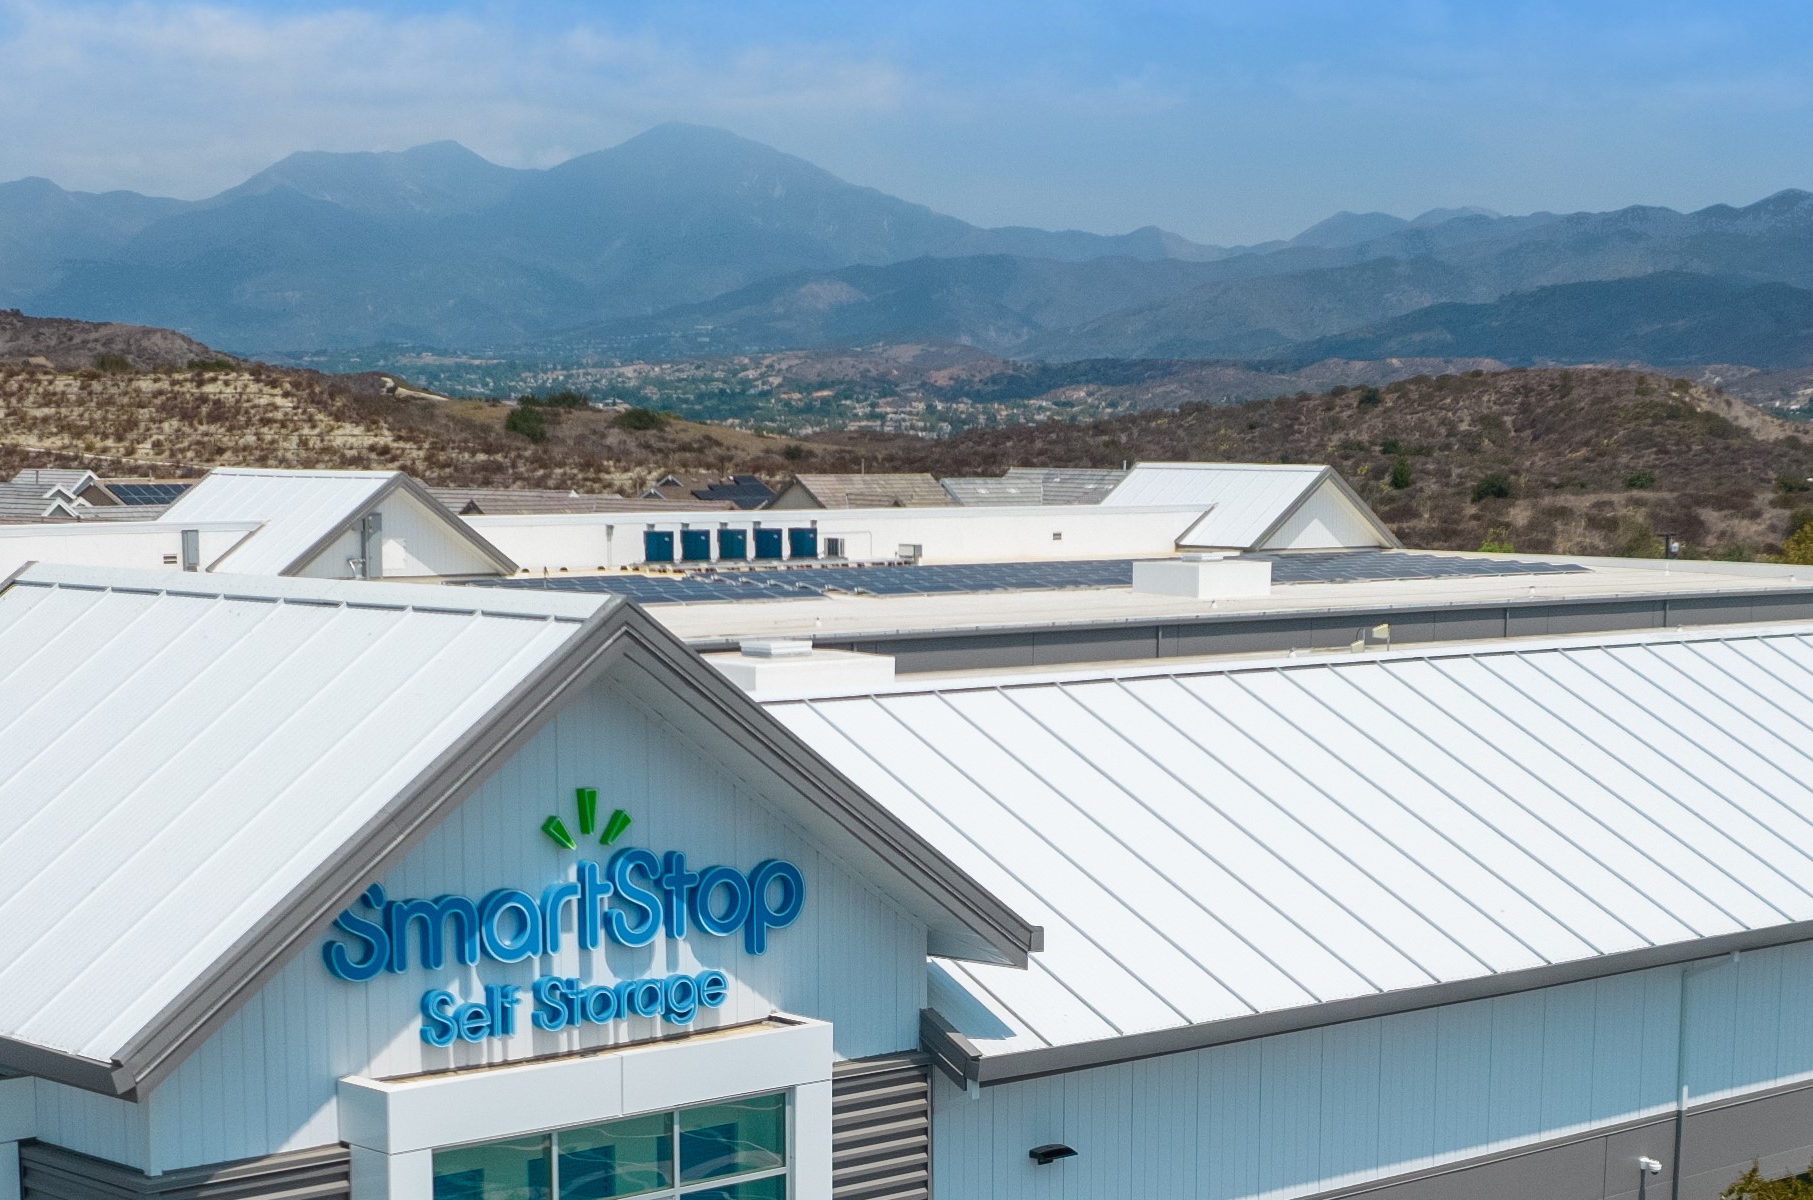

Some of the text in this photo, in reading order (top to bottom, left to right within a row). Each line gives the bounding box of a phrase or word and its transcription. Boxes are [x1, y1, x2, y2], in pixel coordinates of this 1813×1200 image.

[323, 846, 806, 983] SmartStop
[419, 969, 729, 1048] Self Storage
